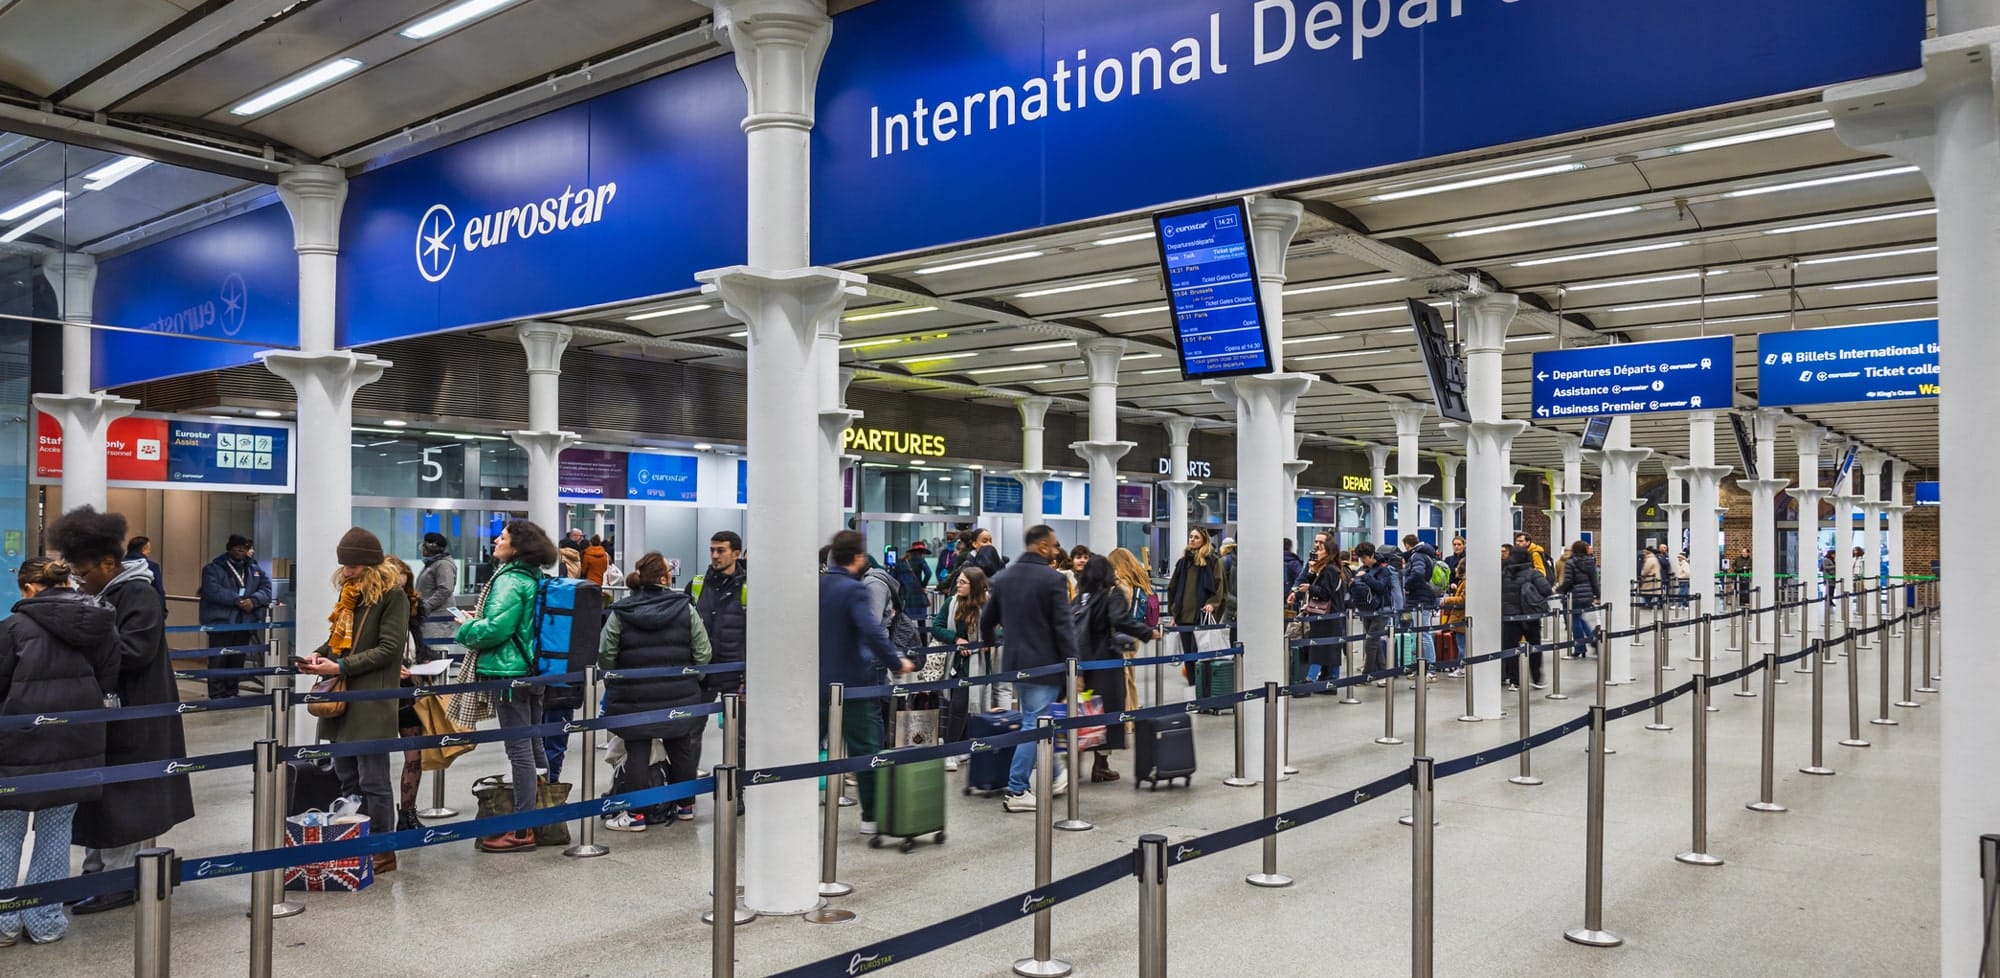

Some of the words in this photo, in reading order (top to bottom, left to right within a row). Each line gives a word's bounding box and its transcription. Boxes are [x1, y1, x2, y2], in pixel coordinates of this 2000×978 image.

[871, 12, 1227, 158] International
[1254, 0, 1462, 65] Depa
[463, 182, 617, 252] eurostar
[1218, 217, 1234, 226] 14:21
[1242, 319, 1257, 327] Open
[1796, 351, 1836, 363] Billets
[1839, 344, 1924, 360] International
[1553, 367, 1611, 381] Departures
[1613, 363, 1656, 377] Départs
[1864, 366, 1905, 378] Ticket
[1553, 385, 1609, 398] Assistance
[1553, 403, 1600, 415] Business
[1601, 400, 1646, 412] Premier
[39, 435, 63, 445] Staf
[175, 430, 211, 439] Eurostar
[175, 438, 199, 446] Assist
[843, 428, 945, 456] PARTURES
[422, 448, 443, 482] 5
[652, 473, 688, 482] eurostar
[1343, 475, 1393, 493] DEPARTES
[916, 478, 930, 503] 4
[859, 955, 893, 972] EUROSTAR
